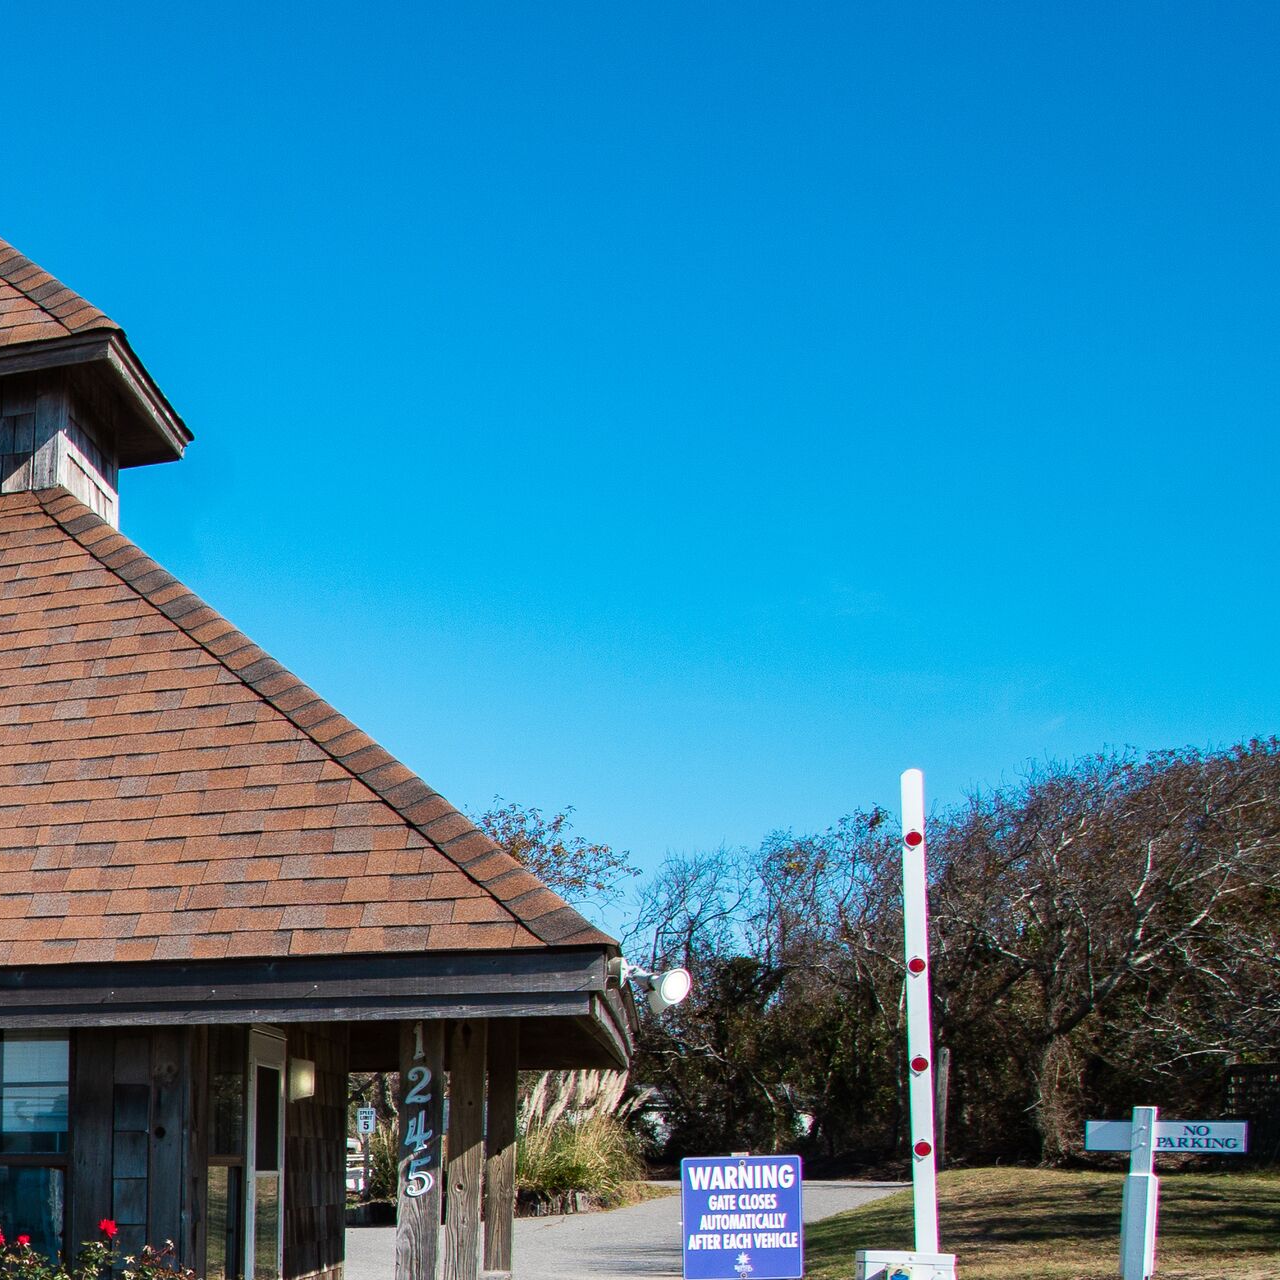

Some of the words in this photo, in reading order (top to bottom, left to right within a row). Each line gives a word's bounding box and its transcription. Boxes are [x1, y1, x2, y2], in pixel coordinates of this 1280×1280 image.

[404, 1020, 435, 1198] 1245
[363, 1120, 370, 1130] 5
[1183, 1124, 1210, 1137] NO
[1156, 1136, 1238, 1149] PARKING
[687, 1164, 795, 1191] WARNING
[708, 1194, 737, 1211] GATE
[738, 1193, 777, 1210] CLOSES
[699, 1212, 787, 1231] AUTOMATICALLY
[687, 1233, 721, 1251] AFTER
[722, 1233, 752, 1250] EACH
[753, 1231, 799, 1249] VEHICLE
